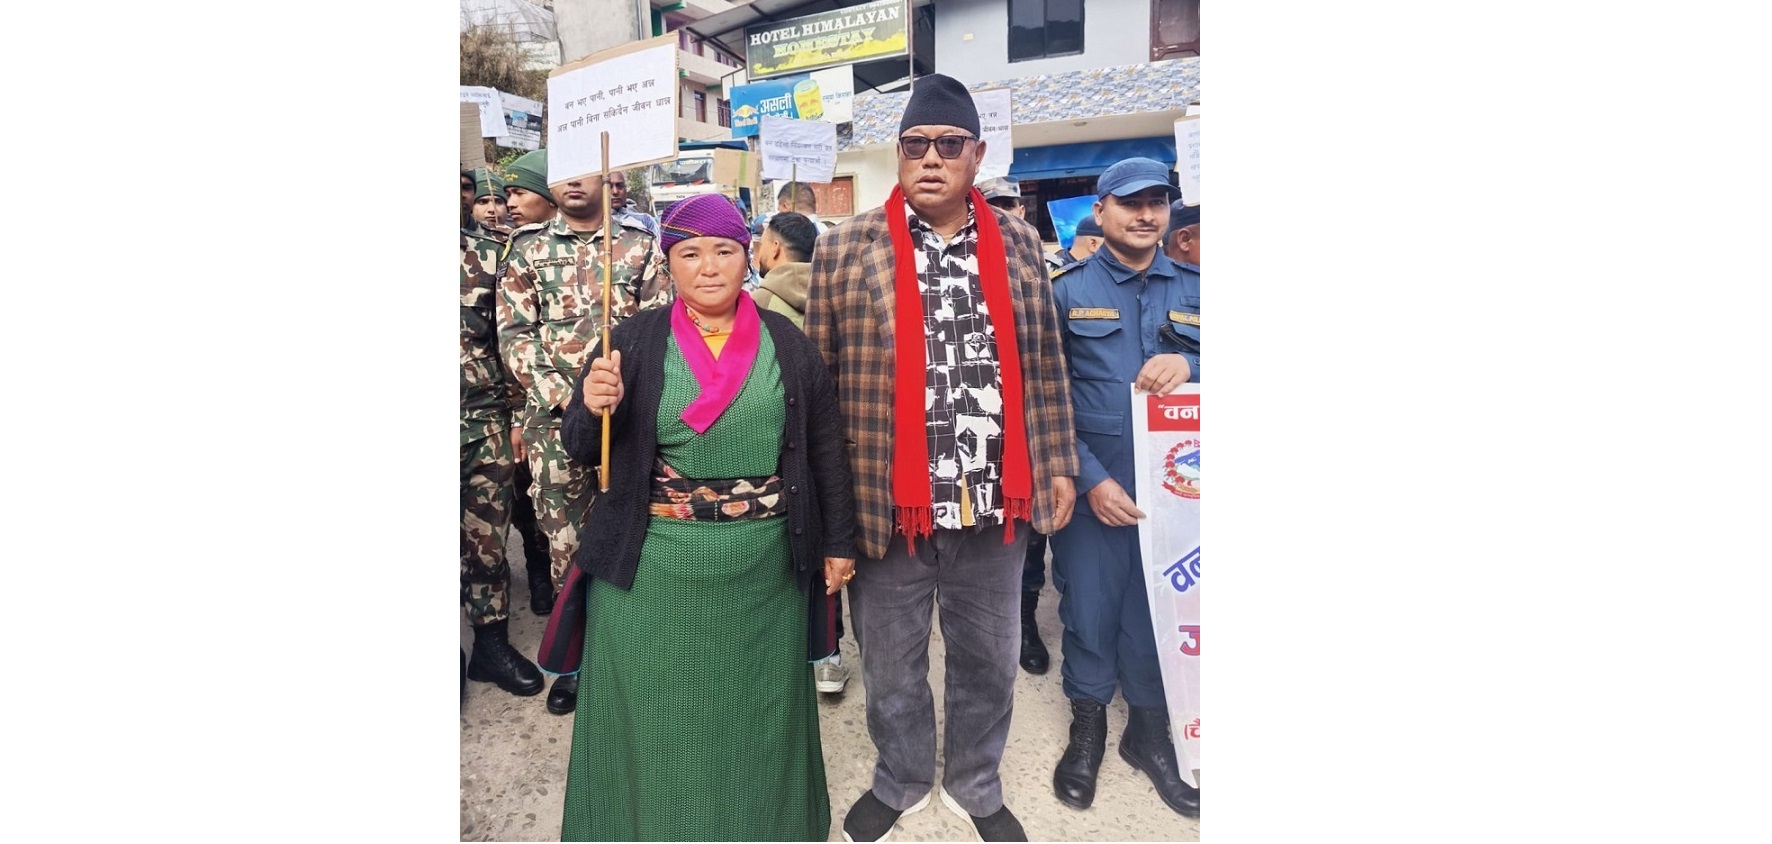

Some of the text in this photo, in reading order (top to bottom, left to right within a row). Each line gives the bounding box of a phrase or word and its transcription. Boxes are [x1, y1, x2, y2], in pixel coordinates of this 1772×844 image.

[750, 6, 900, 46] HOTEL HIMALAYAN
[773, 26, 876, 58] HOMESTAY
[609, 84, 623, 97] पानी
[627, 82, 638, 93] भए
[760, 92, 793, 114] असली
[570, 116, 584, 128] पानी
